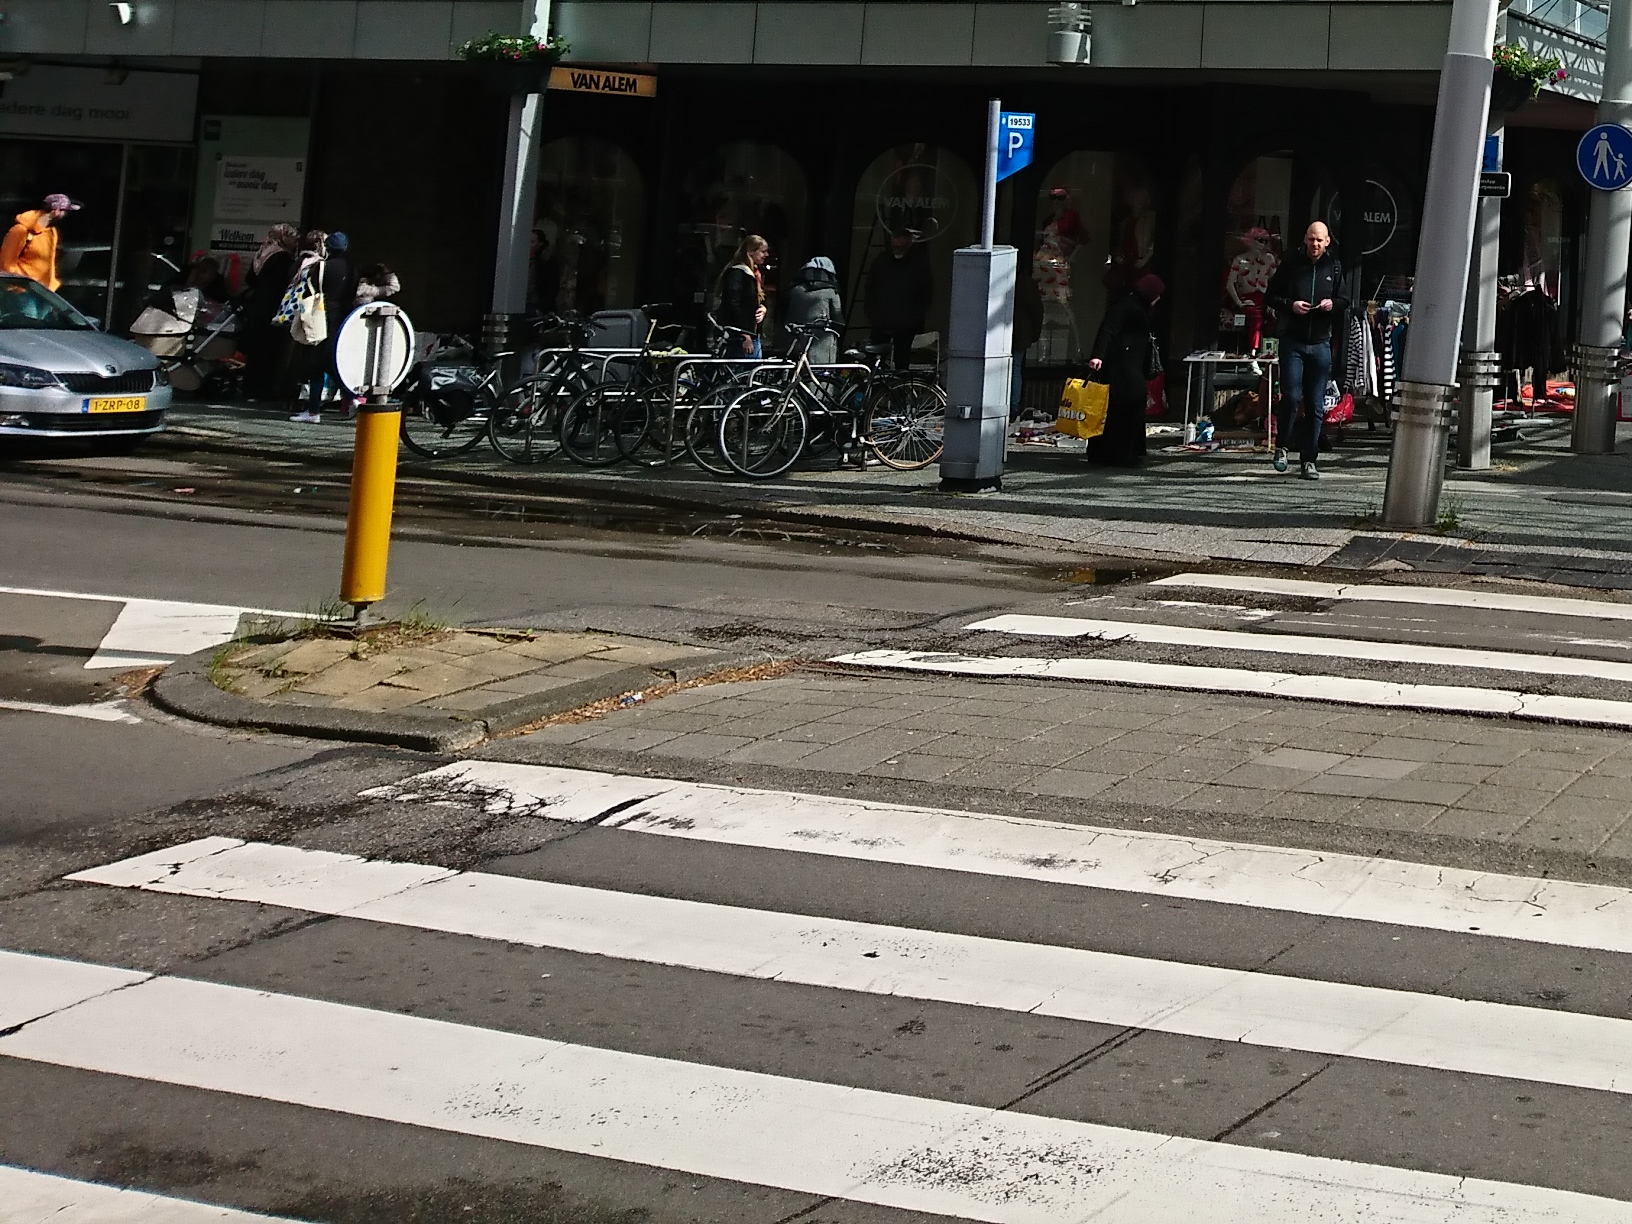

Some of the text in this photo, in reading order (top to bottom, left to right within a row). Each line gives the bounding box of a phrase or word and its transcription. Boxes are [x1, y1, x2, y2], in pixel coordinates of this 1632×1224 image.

[570, 72, 637, 93] VAN ALEM
[1009, 118, 1031, 126] 19533
[1008, 131, 1024, 159] P
[94, 399, 140, 413] 1-ZRP-08
